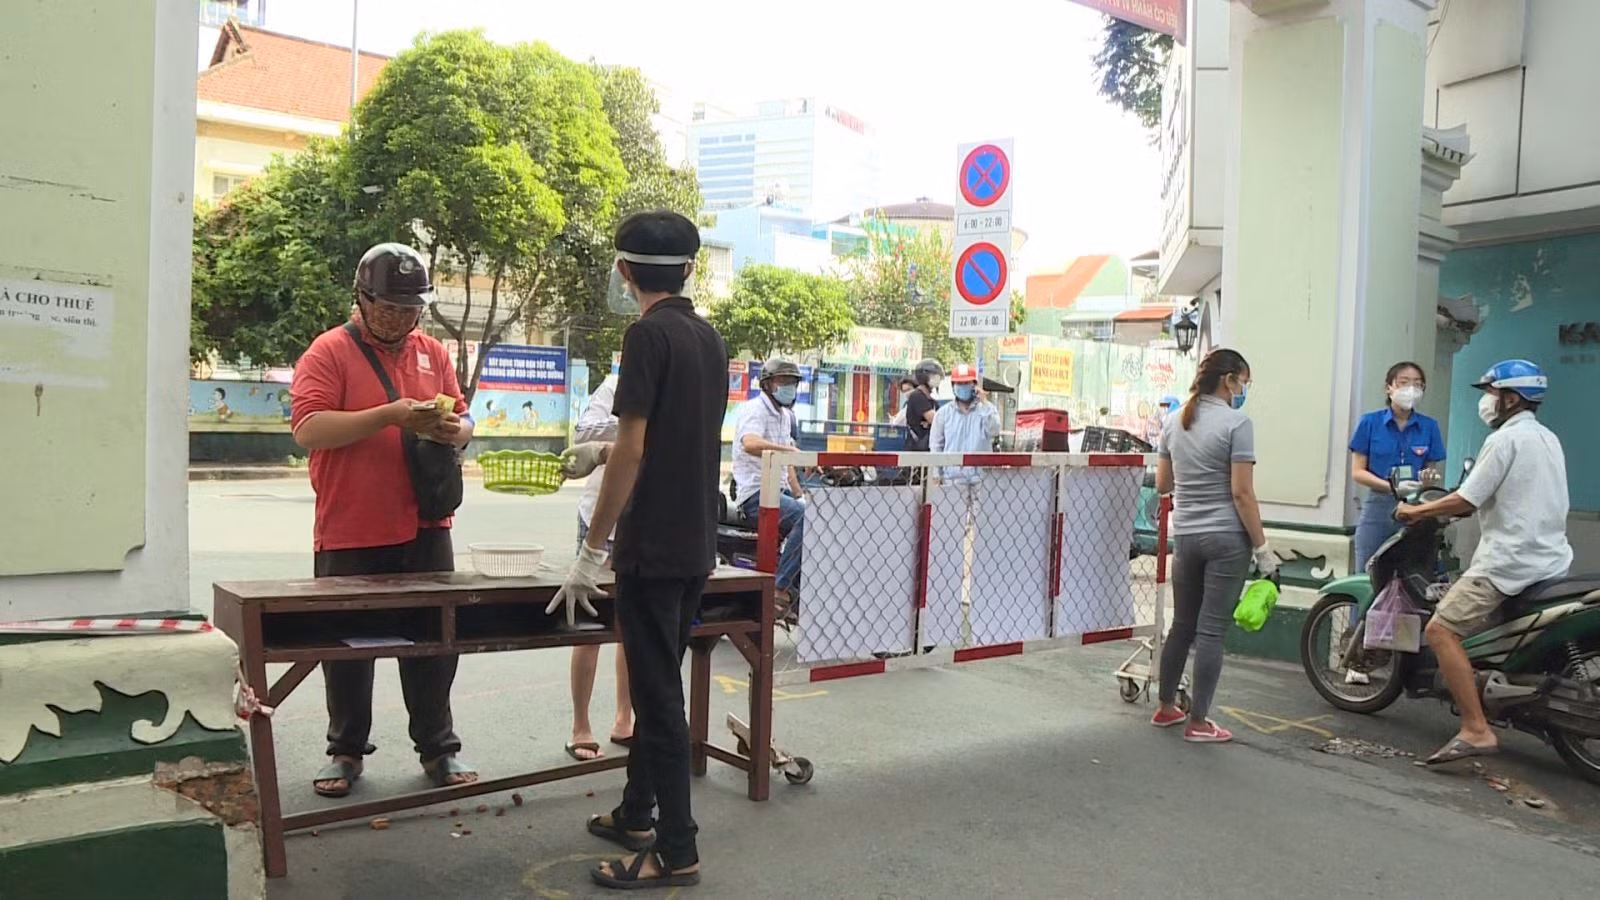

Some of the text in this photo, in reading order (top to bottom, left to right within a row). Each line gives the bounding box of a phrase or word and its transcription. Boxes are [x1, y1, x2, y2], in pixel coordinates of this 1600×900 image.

[15, 292, 50, 306] CHO
[55, 296, 95, 311] THUÊ
[960, 316, 977, 326] 22:00
